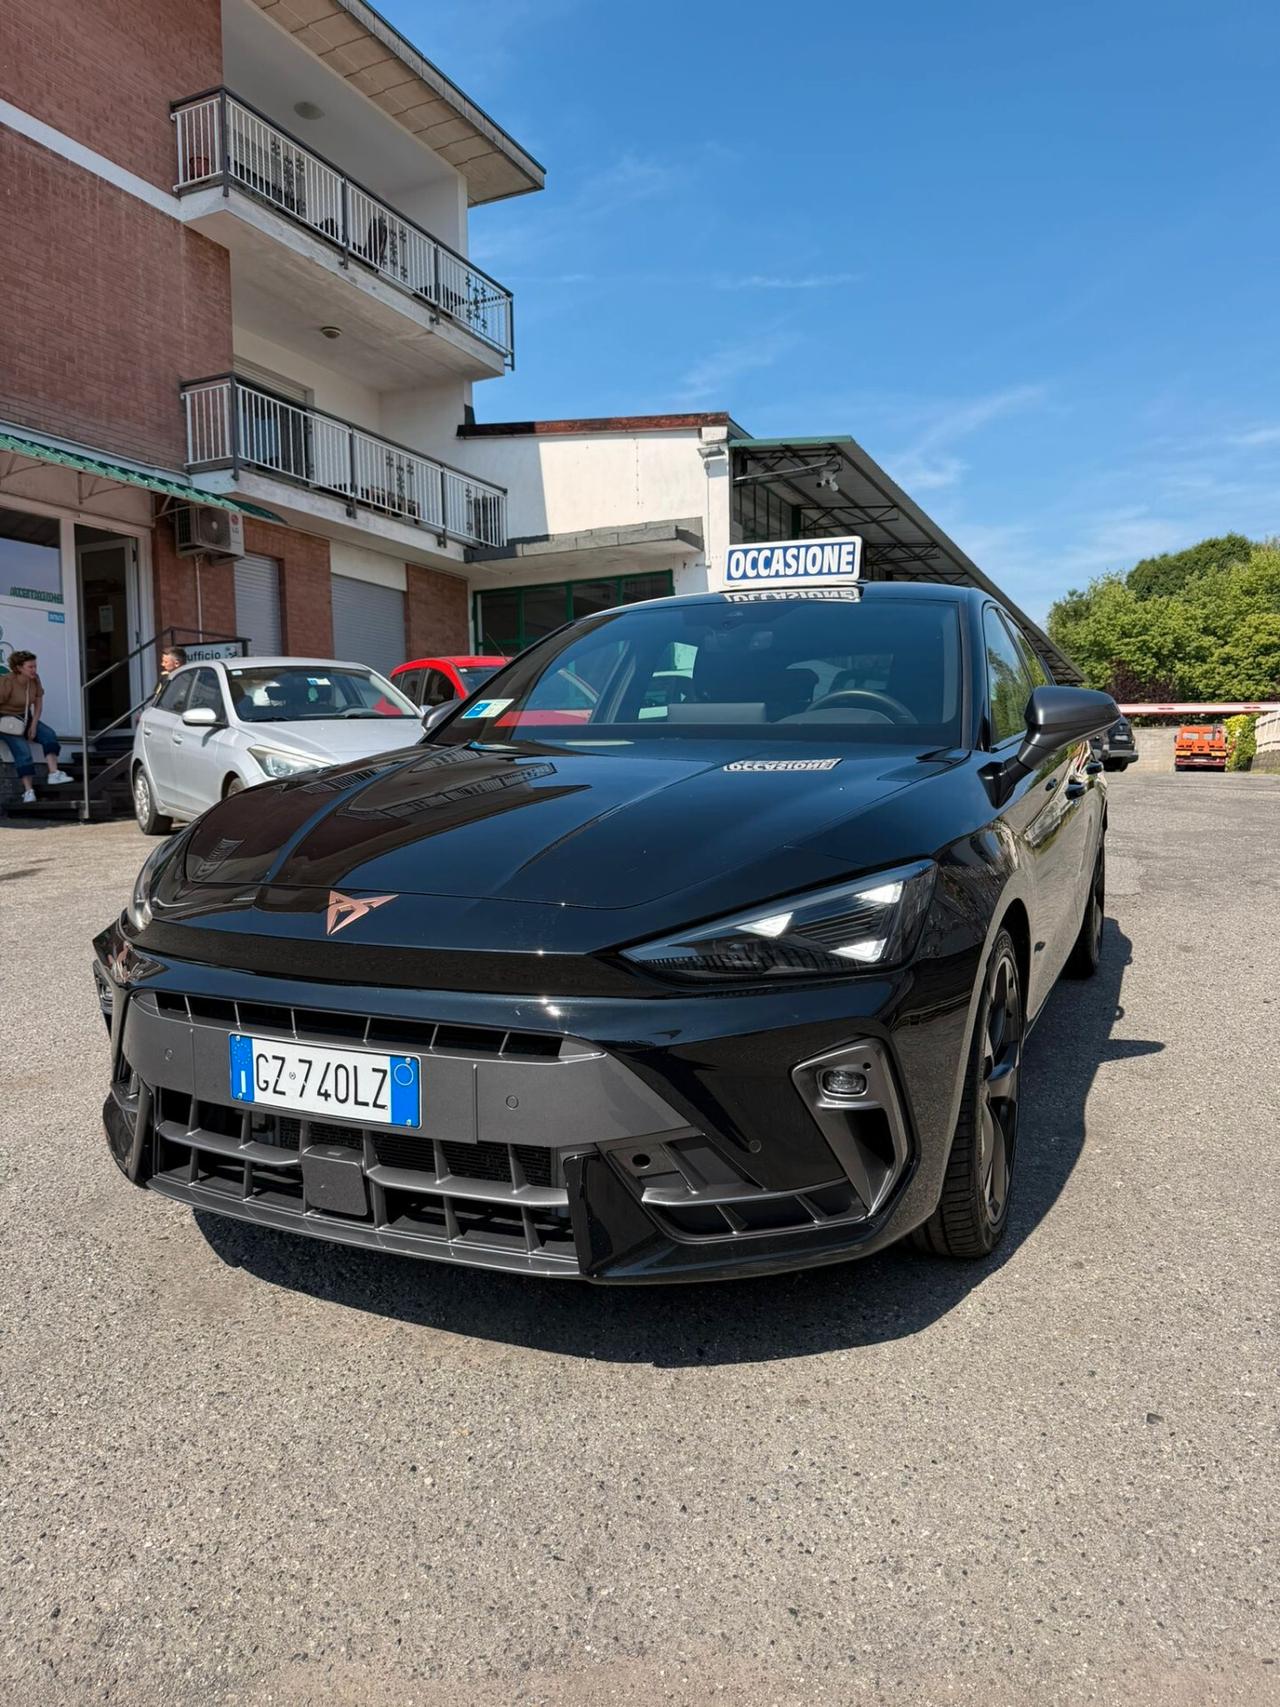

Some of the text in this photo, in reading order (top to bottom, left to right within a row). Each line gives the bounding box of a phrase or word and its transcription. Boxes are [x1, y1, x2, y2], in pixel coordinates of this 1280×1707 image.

[730, 544, 854, 579] OCCASIONE
[187, 650, 221, 661] ufficio
[255, 1053, 286, 1096] GZ
